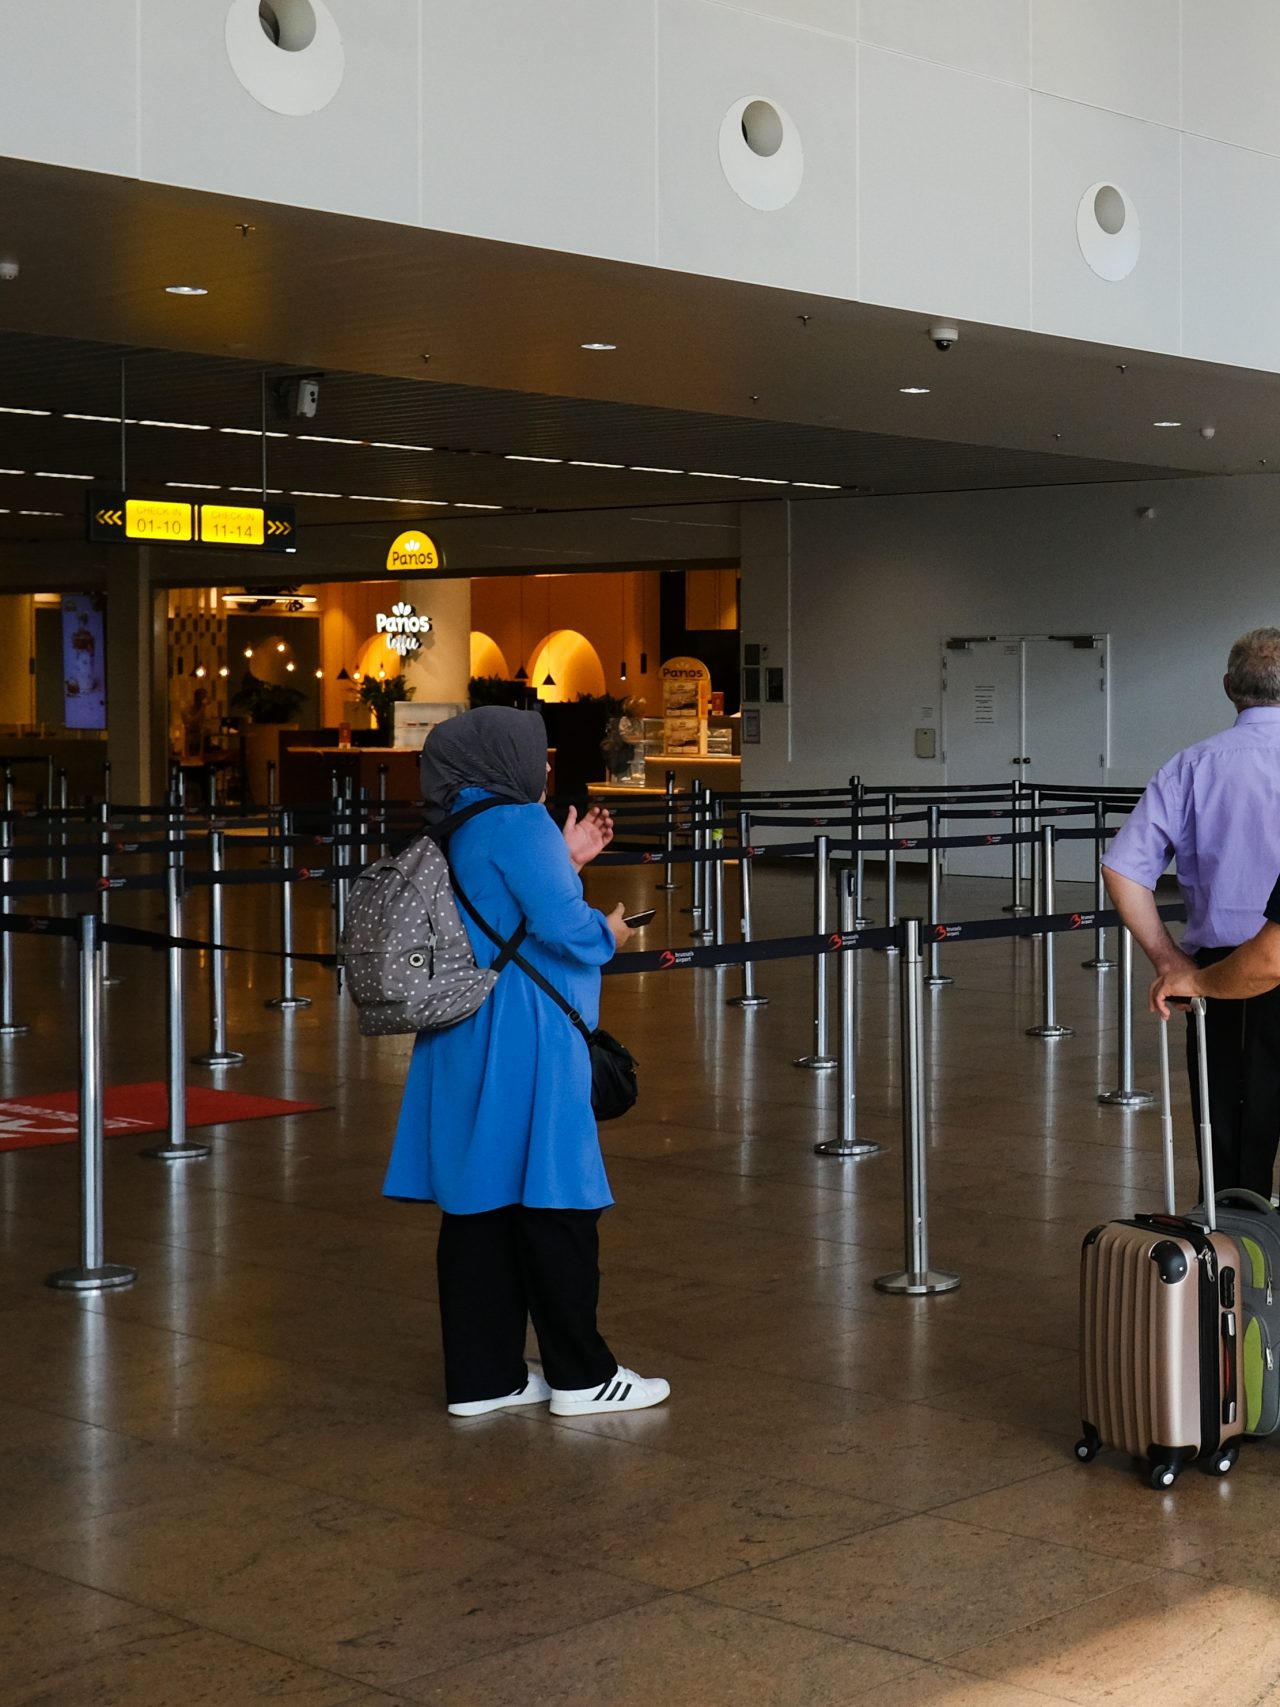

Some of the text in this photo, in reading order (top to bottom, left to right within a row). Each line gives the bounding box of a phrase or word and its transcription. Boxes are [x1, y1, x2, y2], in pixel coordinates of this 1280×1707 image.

[136, 505, 182, 517] CHECK-IN
[211, 510, 255, 522] CHECK-IN
[136, 518, 182, 535] 01-10
[213, 523, 253, 538] 11-14
[392, 551, 434, 566] Panos
[375, 612, 430, 634] Panos
[662, 667, 704, 678] Panos
